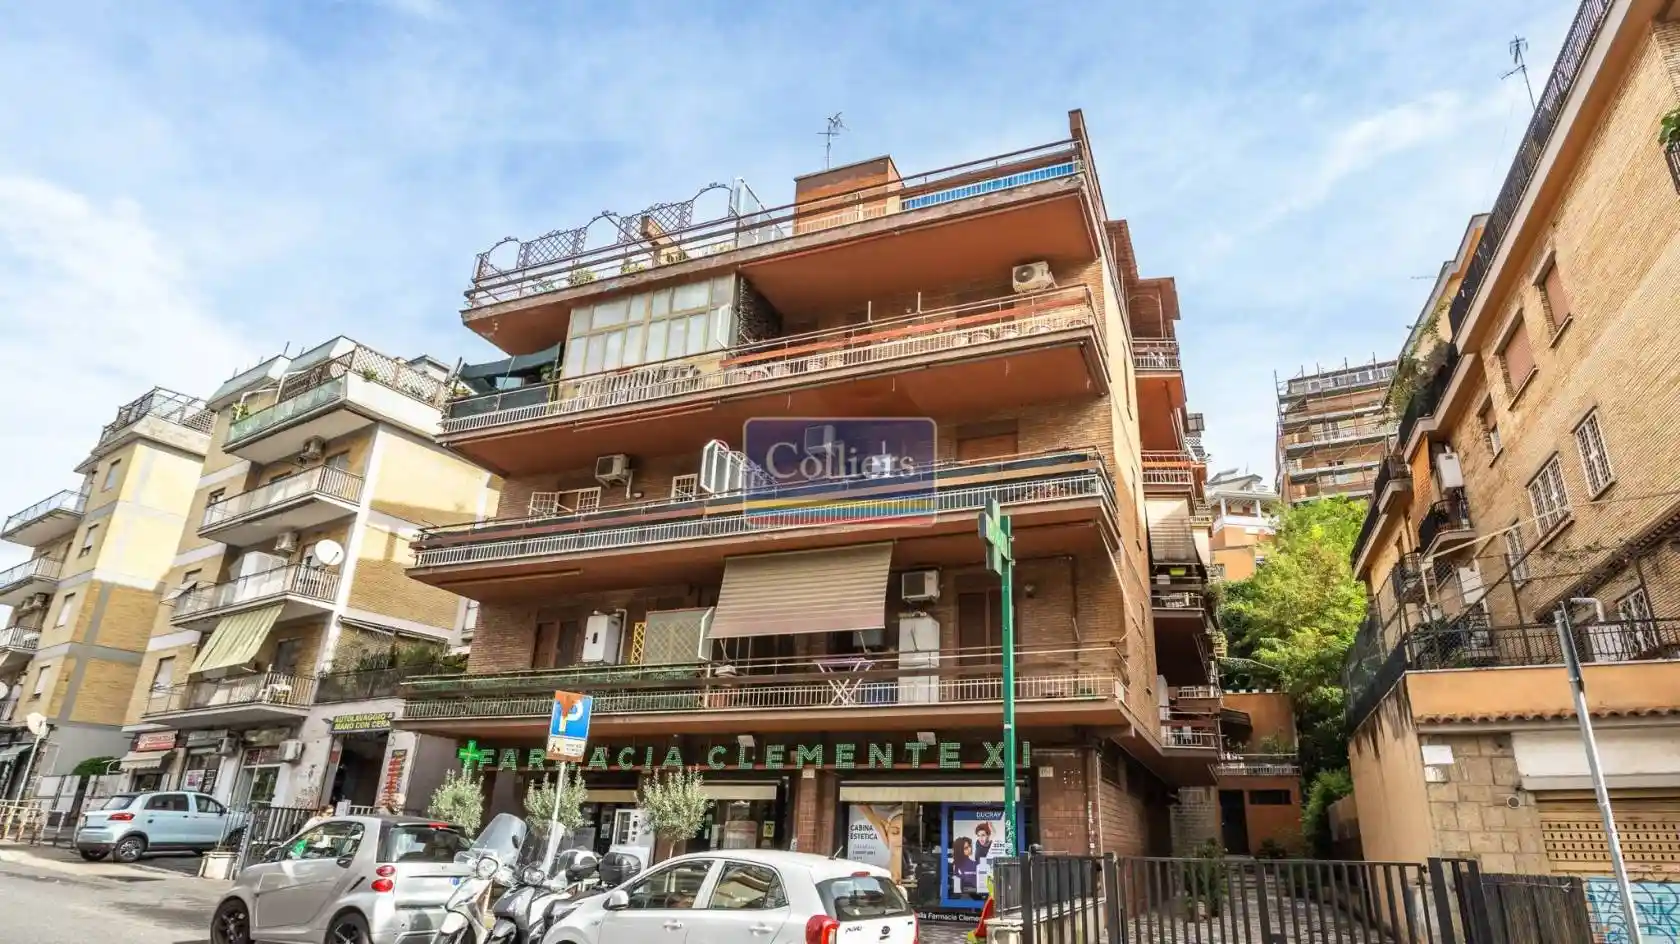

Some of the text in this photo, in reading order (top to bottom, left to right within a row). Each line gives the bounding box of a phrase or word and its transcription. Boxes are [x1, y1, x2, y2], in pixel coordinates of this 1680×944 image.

[334, 713, 386, 723] AUTOLAVAGGIO
[558, 699, 584, 732] P
[333, 719, 391, 730] MANO CON CERA
[478, 740, 1031, 772] FARACIA CLEMENTE XI
[976, 811, 1002, 819] DUCRAY
[928, 912, 957, 920] Farmacia
